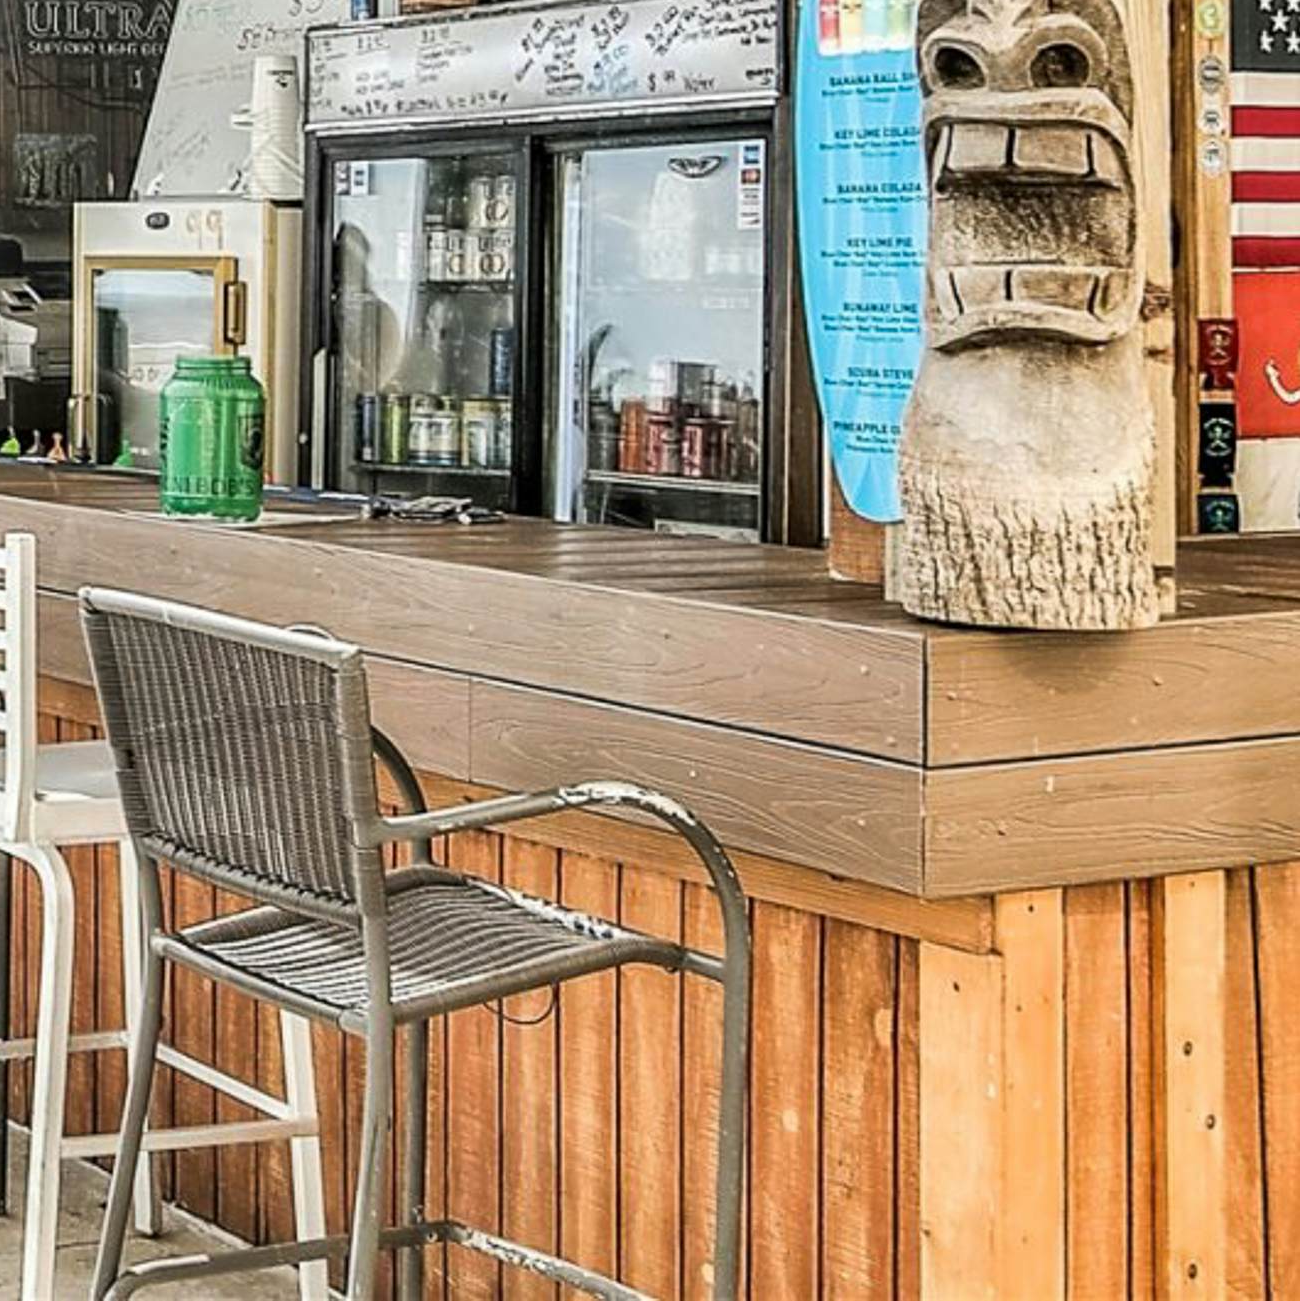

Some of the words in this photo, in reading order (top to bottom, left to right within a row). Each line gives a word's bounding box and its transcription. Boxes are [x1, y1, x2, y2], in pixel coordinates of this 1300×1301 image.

[24, 1, 172, 39] ULTRA
[856, 128, 880, 139] LIME
[837, 184, 879, 194] BANANA
[868, 237, 893, 248] LIME
[895, 236, 912, 248] PIE
[892, 303, 917, 314] LIME
[833, 421, 887, 434] PINEAPPLE
